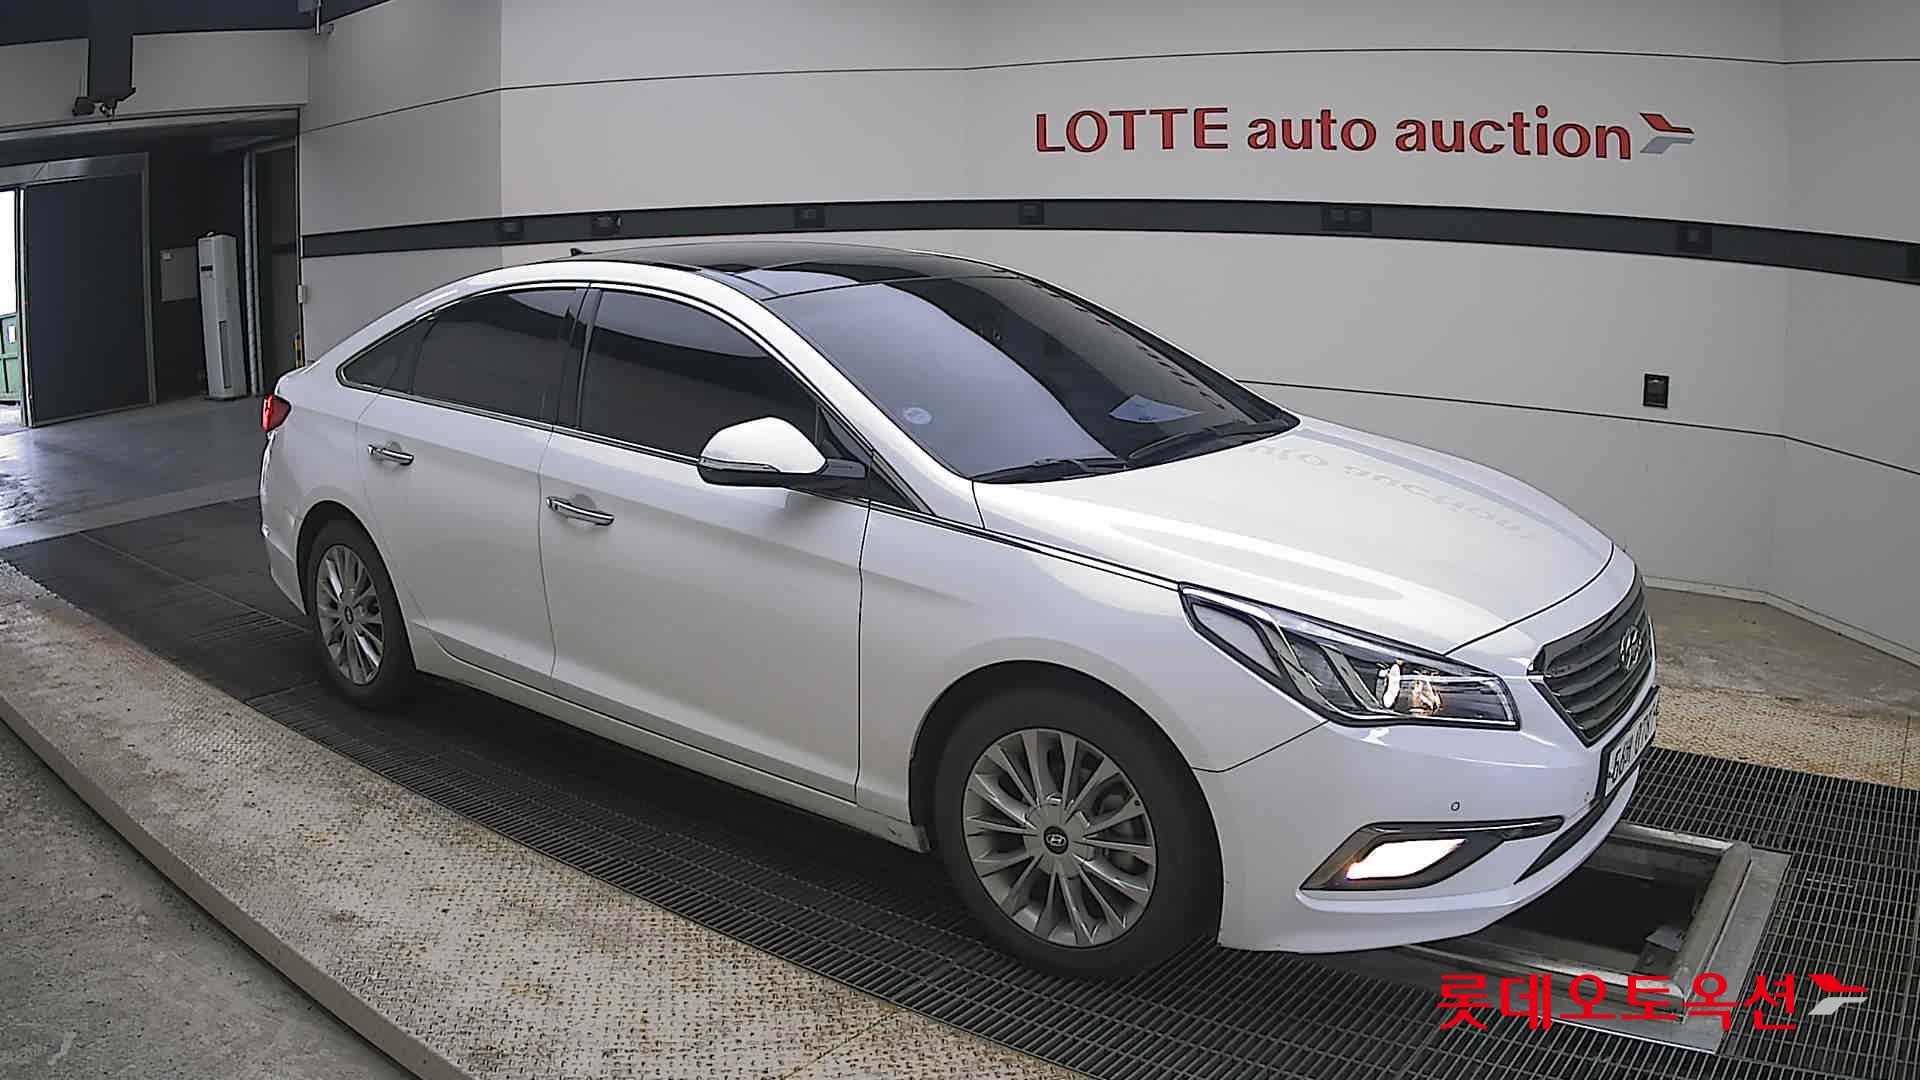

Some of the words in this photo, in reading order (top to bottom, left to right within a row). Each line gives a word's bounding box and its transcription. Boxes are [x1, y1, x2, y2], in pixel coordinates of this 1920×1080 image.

[1036, 108, 1228, 152] LOTTE
[1247, 109, 1377, 151] auto
[1395, 105, 1631, 160] auction
